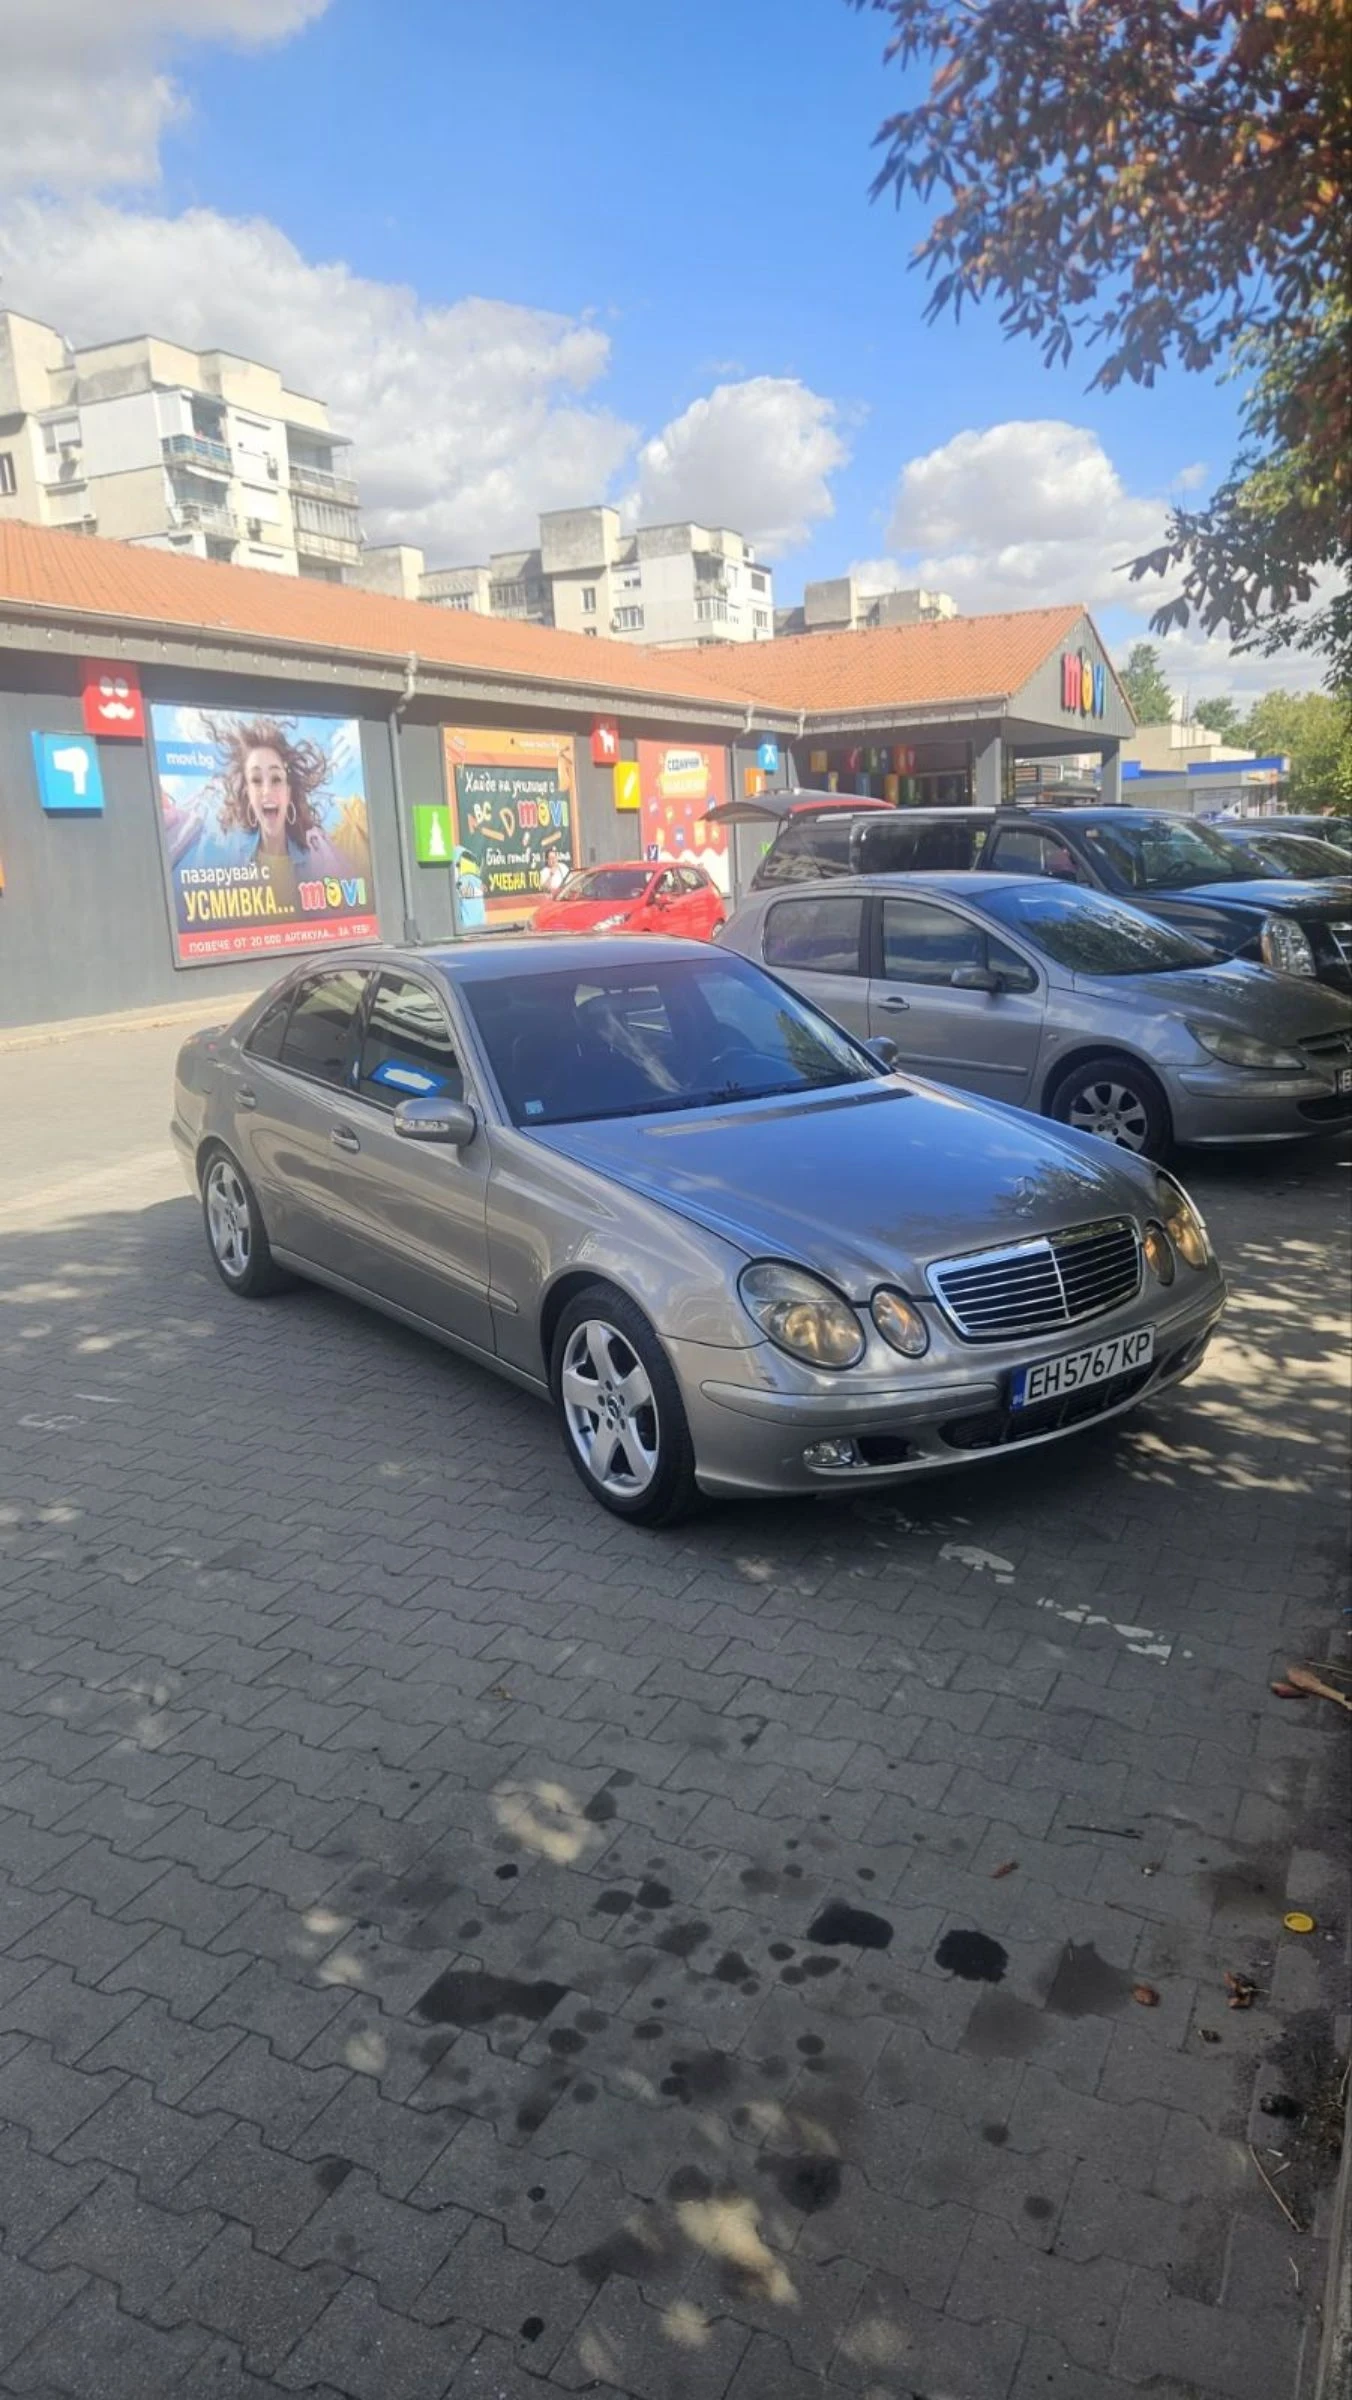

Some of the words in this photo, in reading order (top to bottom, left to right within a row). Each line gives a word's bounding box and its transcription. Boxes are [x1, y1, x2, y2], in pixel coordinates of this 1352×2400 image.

[166, 750, 215, 770] movi.bg
[465, 771, 496, 792] Хайде
[498, 780, 511, 792] на
[180, 863, 259, 887] пазарувай
[261, 865, 270, 879] с
[488, 870, 526, 892] УЧЕБНА
[184, 886, 295, 922] УСМИВКА...
[189, 940, 230, 953] ПОВЕЧЕ
[234, 938, 247, 949] ОТ
[251, 936, 262, 947] 20
